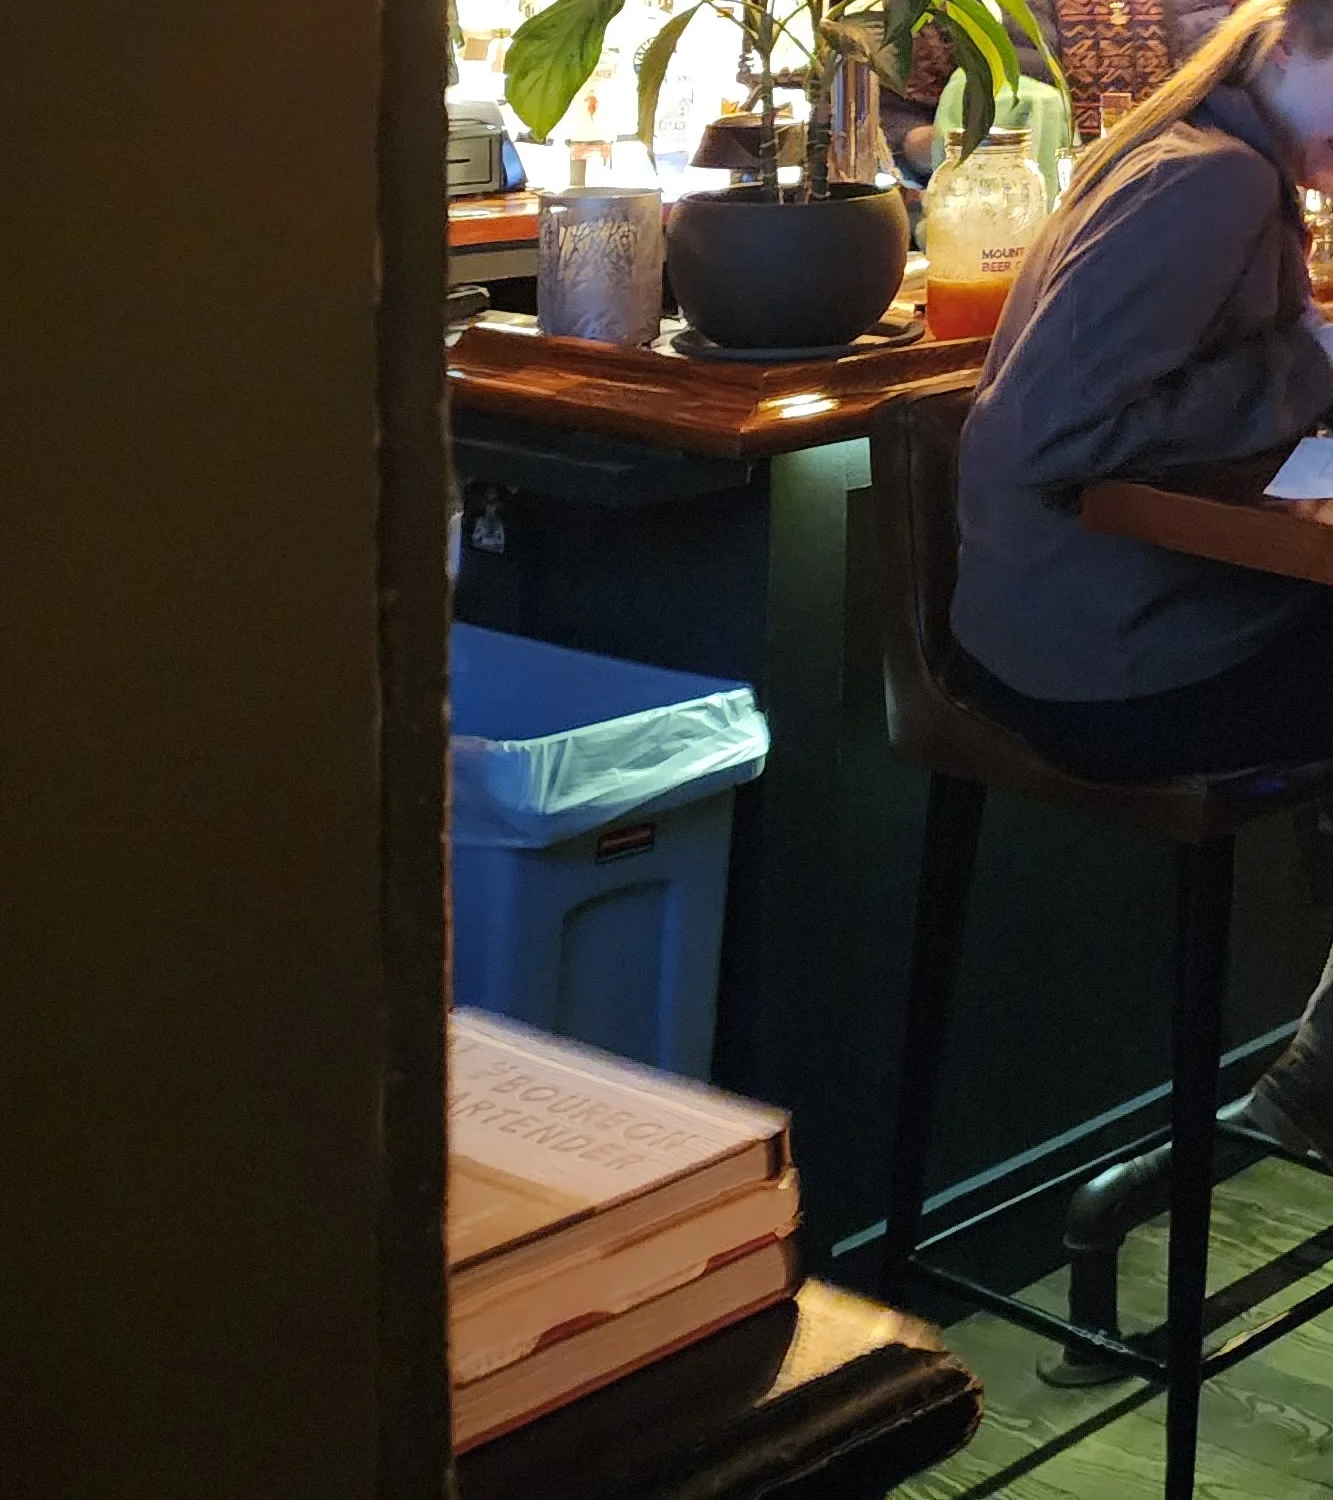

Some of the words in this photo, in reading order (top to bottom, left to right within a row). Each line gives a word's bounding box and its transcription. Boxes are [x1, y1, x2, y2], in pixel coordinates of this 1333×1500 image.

[981, 247, 1025, 259] MOUNT
[449, 1090, 646, 1171] ARTENDER
[490, 1074, 698, 1151] BOURBON
